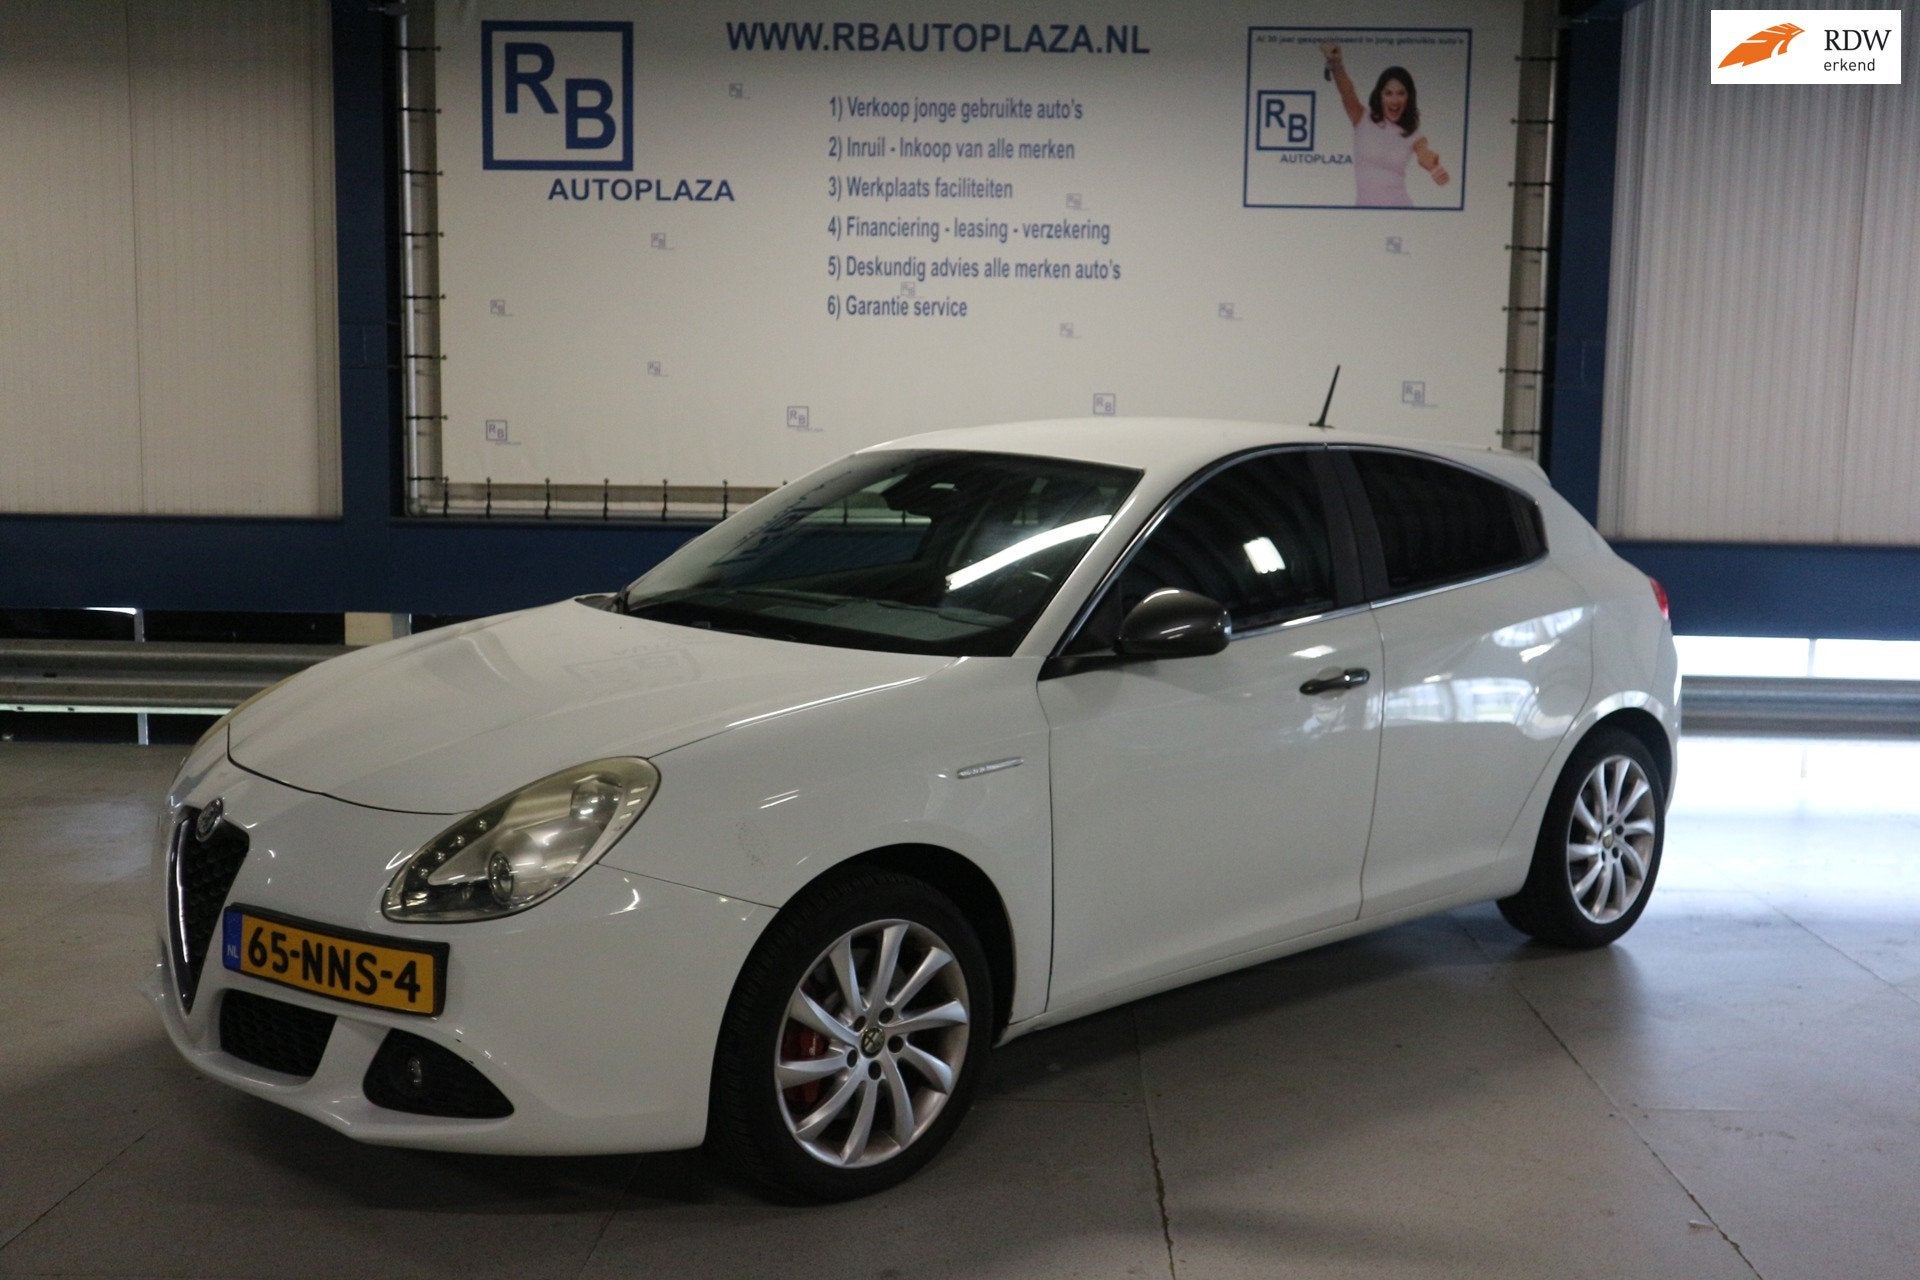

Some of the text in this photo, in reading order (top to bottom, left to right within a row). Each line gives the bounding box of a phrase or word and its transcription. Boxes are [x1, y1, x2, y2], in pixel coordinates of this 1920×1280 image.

[726, 22, 1150, 54] WWW.RBAUTOPLAZA.NL
[504, 42, 616, 149] RB
[829, 97, 1083, 123] 1) Verkoop jonge gebruikte auto's
[1265, 99, 1308, 142] RB
[828, 136, 842, 162] 2)
[847, 137, 885, 157] Inruil
[900, 137, 951, 162] Inkoop
[956, 143, 983, 158] van
[988, 138, 1014, 158] alle
[1018, 139, 1075, 159] merken
[1280, 154, 1353, 164] AUTOPLAZA
[548, 178, 735, 201] AUTOPLAZA
[828, 176, 1013, 201] 3) Werkplaats faciliteiten
[828, 216, 841, 241] 4)
[846, 215, 939, 242] Financiering
[954, 217, 1008, 243] leasing
[1023, 219, 1110, 245] verzekering
[828, 255, 1121, 282] 5) Deskundig advies alle merken auto's
[827, 295, 968, 321] 6) Garantie service
[227, 944, 239, 959] NL
[248, 926, 421, 1004] 65-NNS-4
